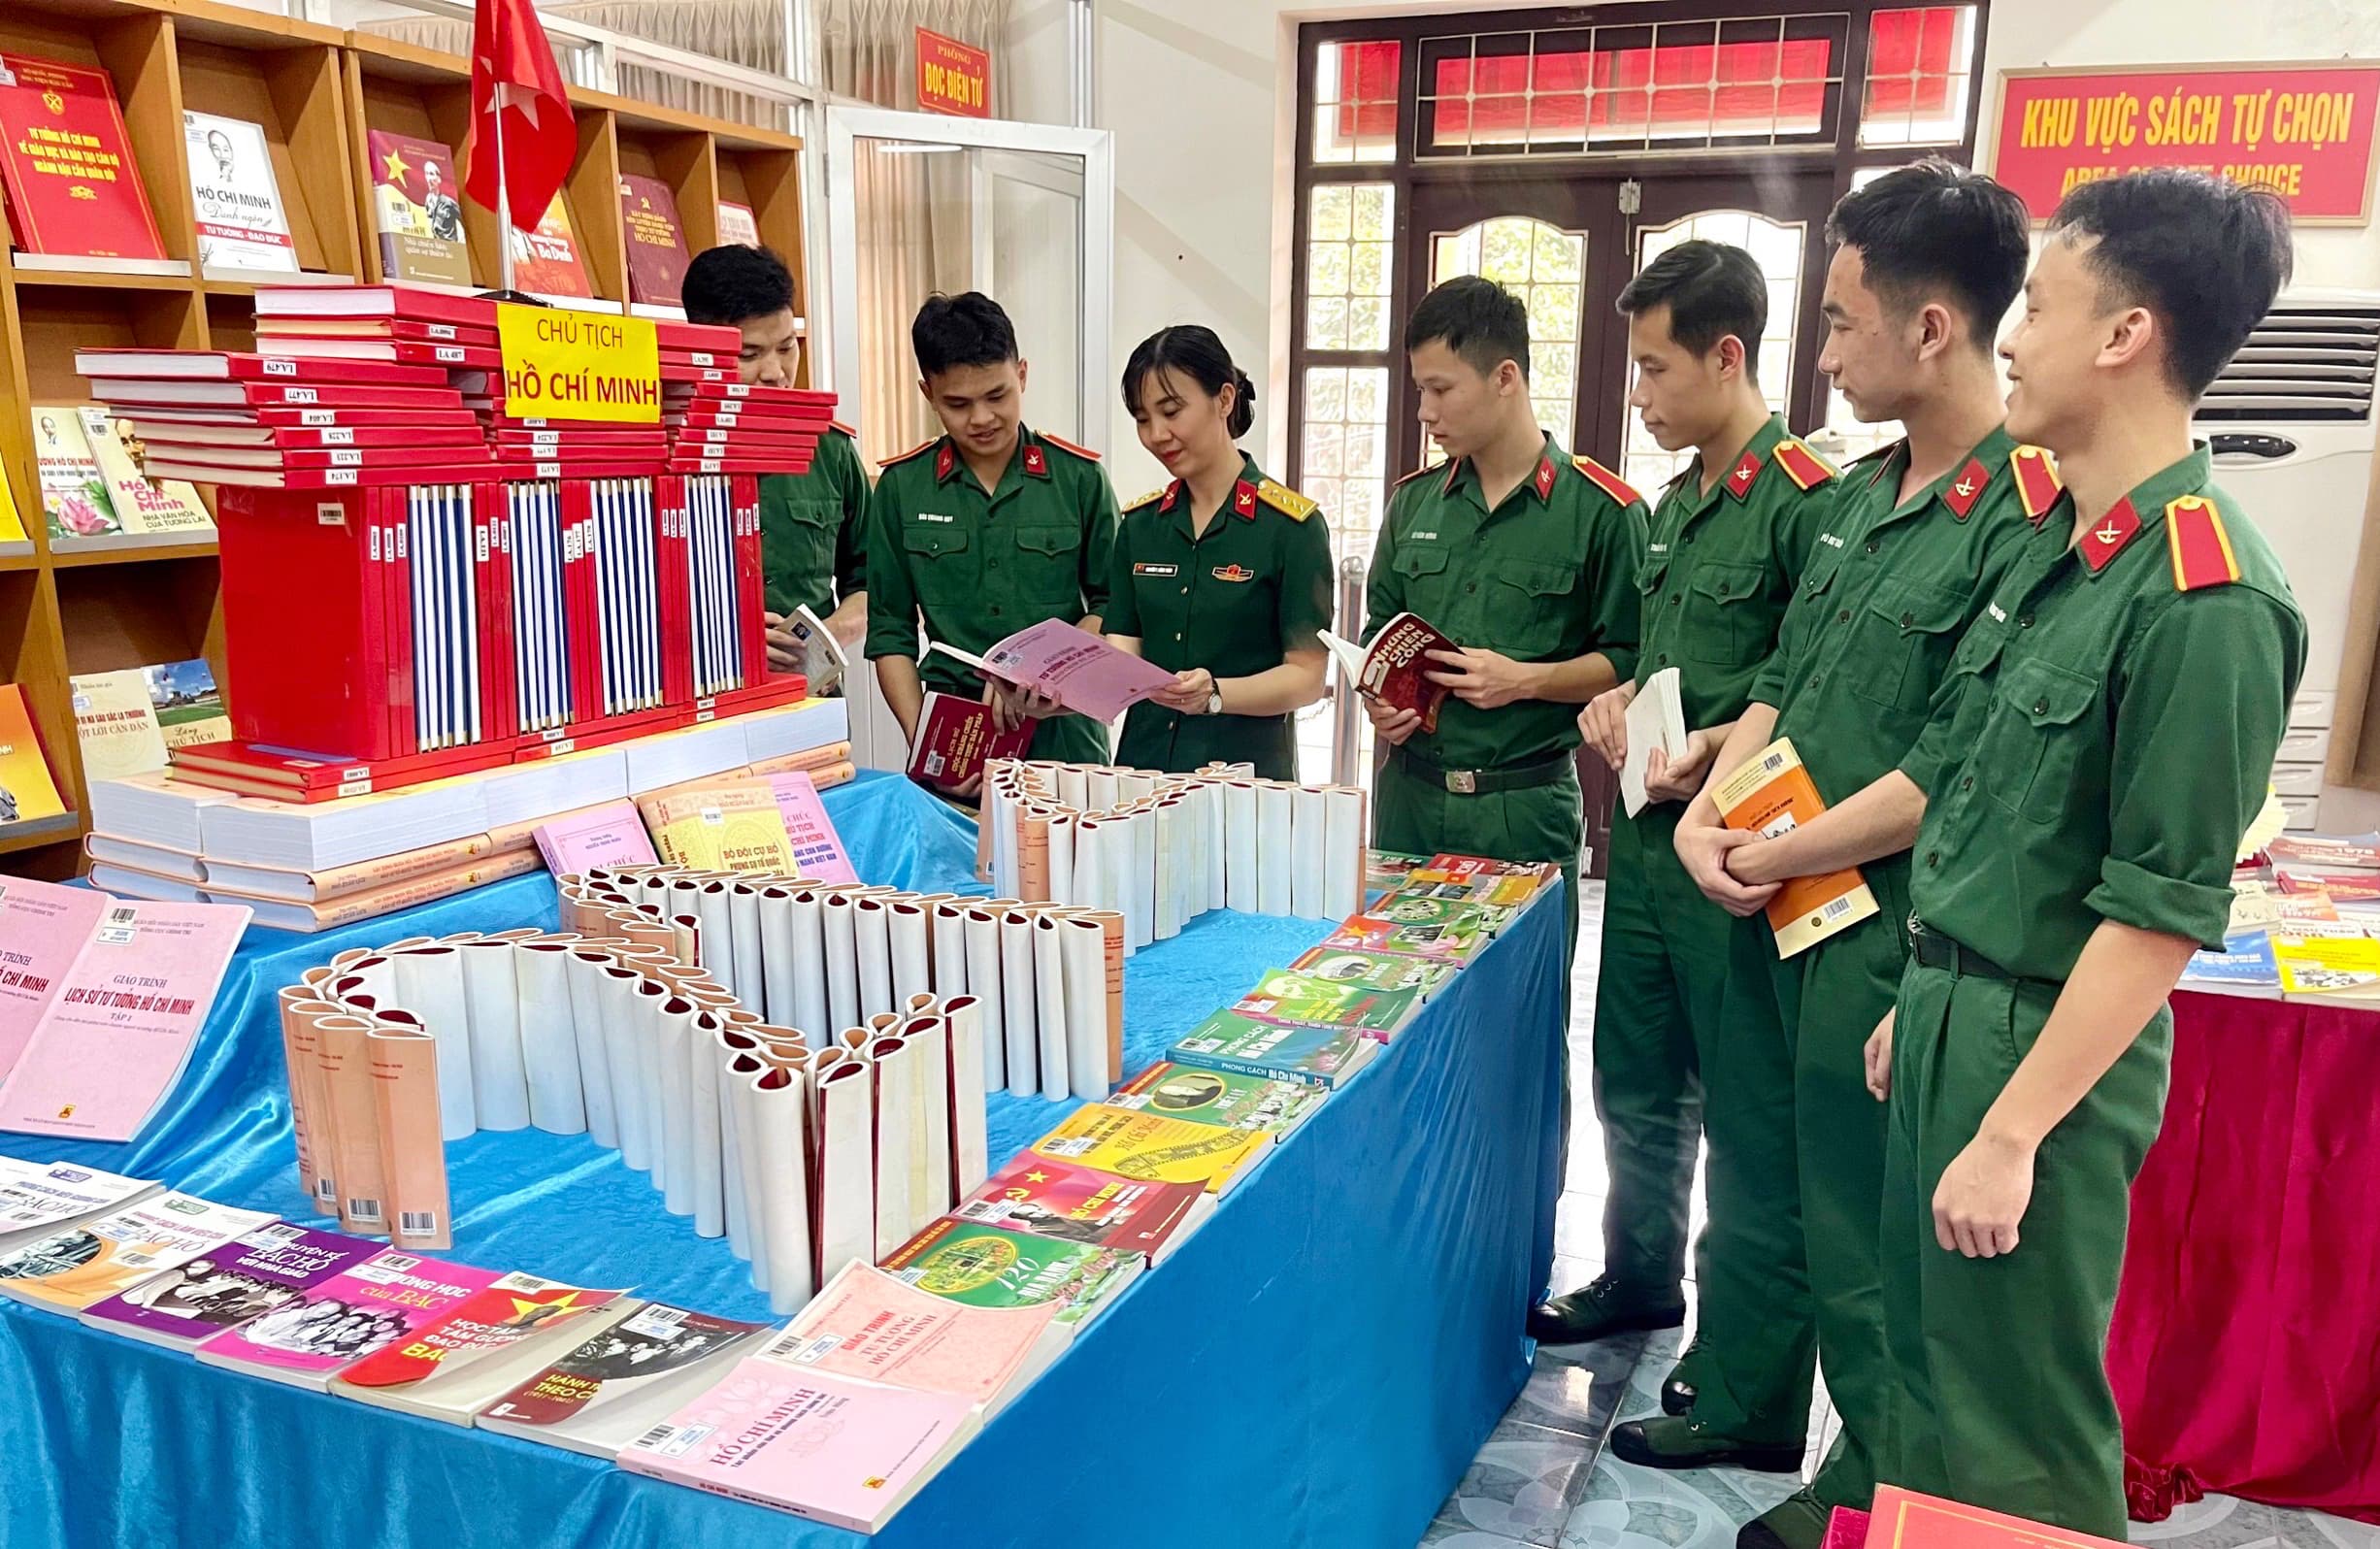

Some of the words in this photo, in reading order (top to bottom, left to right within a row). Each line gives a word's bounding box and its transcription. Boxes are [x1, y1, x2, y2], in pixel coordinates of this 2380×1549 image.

[925, 61, 945, 101] ĐỌC
[947, 65, 970, 108] ĐIỆN
[971, 65, 983, 109] TỬ
[2021, 98, 2078, 148] KHU
[2085, 91, 2139, 153] VỰC
[2144, 85, 2222, 147] SÁCH
[2232, 88, 2273, 151] TỰ
[2272, 92, 2355, 150] CHỌN
[239, 193, 272, 210] MINH
[537, 313, 578, 344] CHỦ
[583, 322, 623, 349] TỊCH
[506, 359, 542, 399] HỒ
[549, 367, 589, 402] CHÍ
[596, 376, 657, 406] MINH
[138, 499, 185, 512] Minh
[79, 726, 91, 740] ỘT
[3, 952, 32, 966] TRÌNH
[19, 974, 50, 993] MINH
[114, 974, 138, 986] GIÁO
[138, 976, 167, 988] TRÌNH
[64, 987, 87, 1005] LỊCH
[168, 999, 195, 1015] MINH
[1221, 1063, 1246, 1072] PHONG
[1247, 1066, 1267, 1076] CÁCH
[286, 1242, 326, 1256] HUYỆN
[996, 1257, 1041, 1291] 120
[360, 1286, 393, 1301] của
[390, 1289, 449, 1309] BÁC
[431, 1283, 472, 1298] HỌC
[450, 1318, 490, 1333] HỌC
[841, 1334, 869, 1351] GIÁO
[862, 1310, 896, 1333] TRÌNH
[534, 1382, 577, 1397] THEO
[545, 1374, 590, 1389] HÀNH
[709, 1443, 743, 1467] HỒ
[737, 1420, 775, 1445] CHÍ
[766, 1388, 816, 1423] MINH
